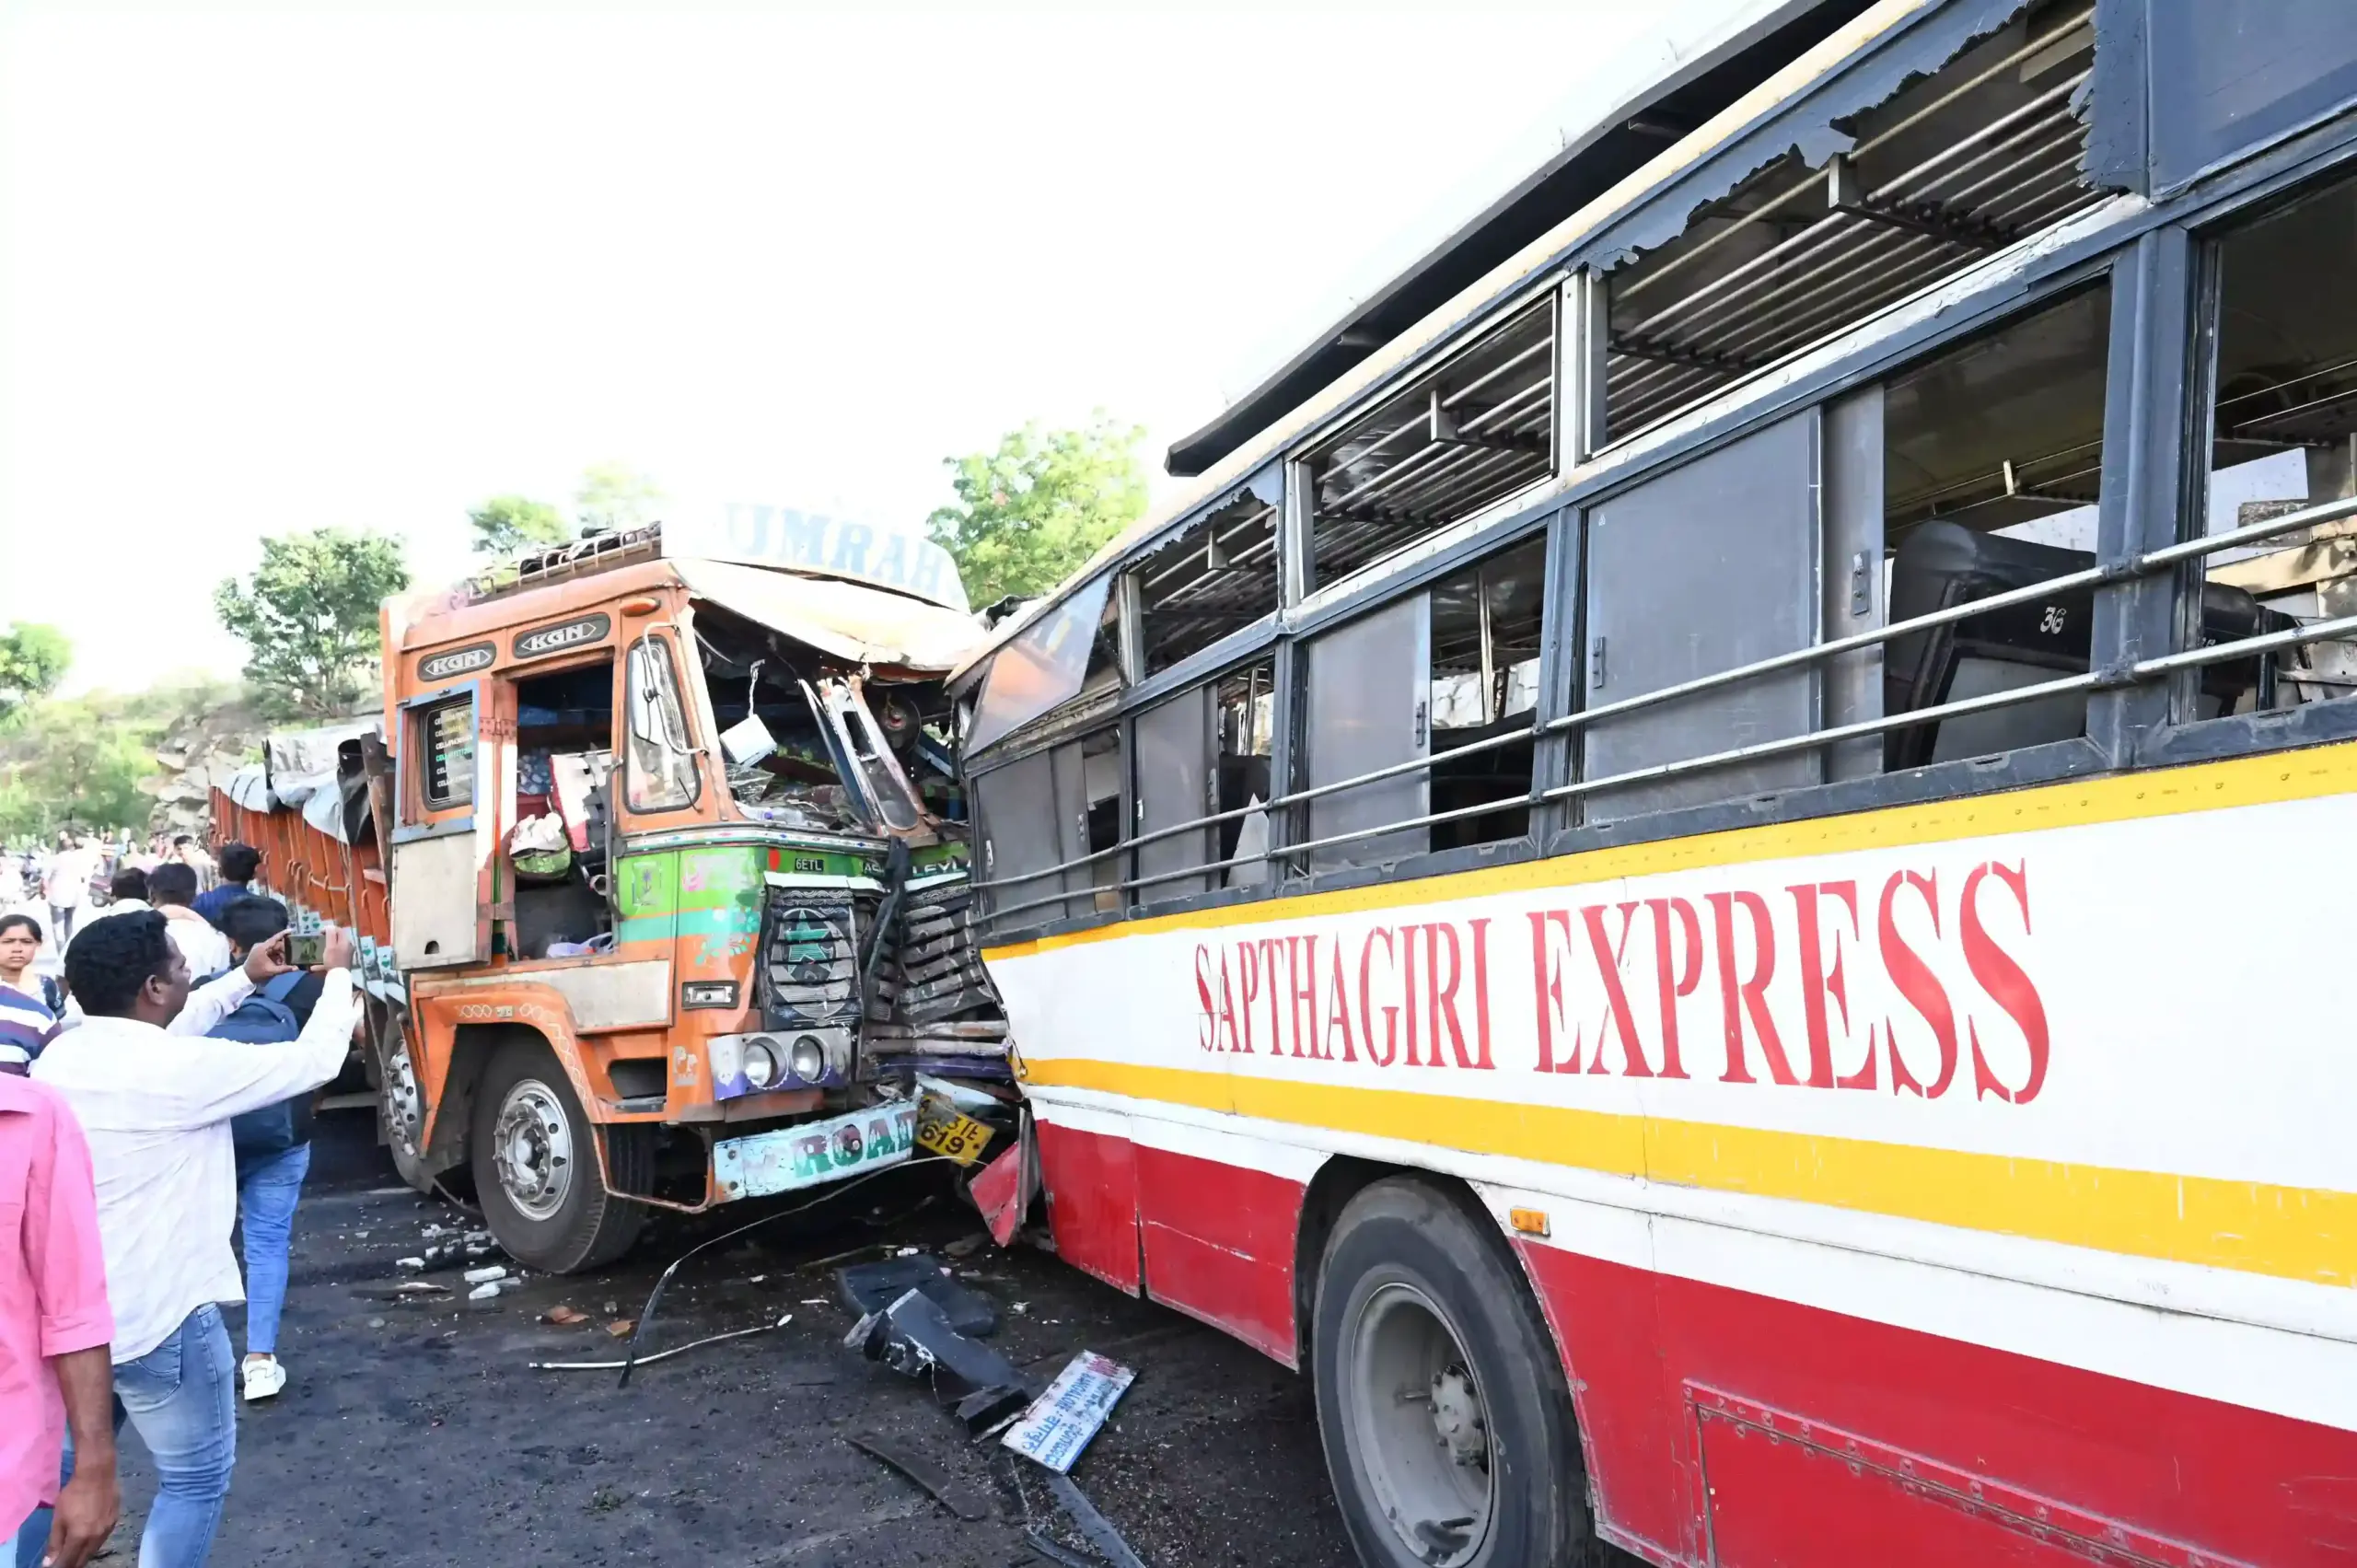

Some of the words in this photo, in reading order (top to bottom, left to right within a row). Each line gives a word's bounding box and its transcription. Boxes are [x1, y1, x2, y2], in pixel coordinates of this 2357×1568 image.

[725, 502, 945, 596] UMRAH
[2039, 606, 2067, 634] 36
[531, 623, 583, 650] KGN
[433, 651, 481, 675] KGN
[1195, 918, 1495, 1070] SAPTHAGIRI
[1527, 858, 2051, 1105] EXPRESS
